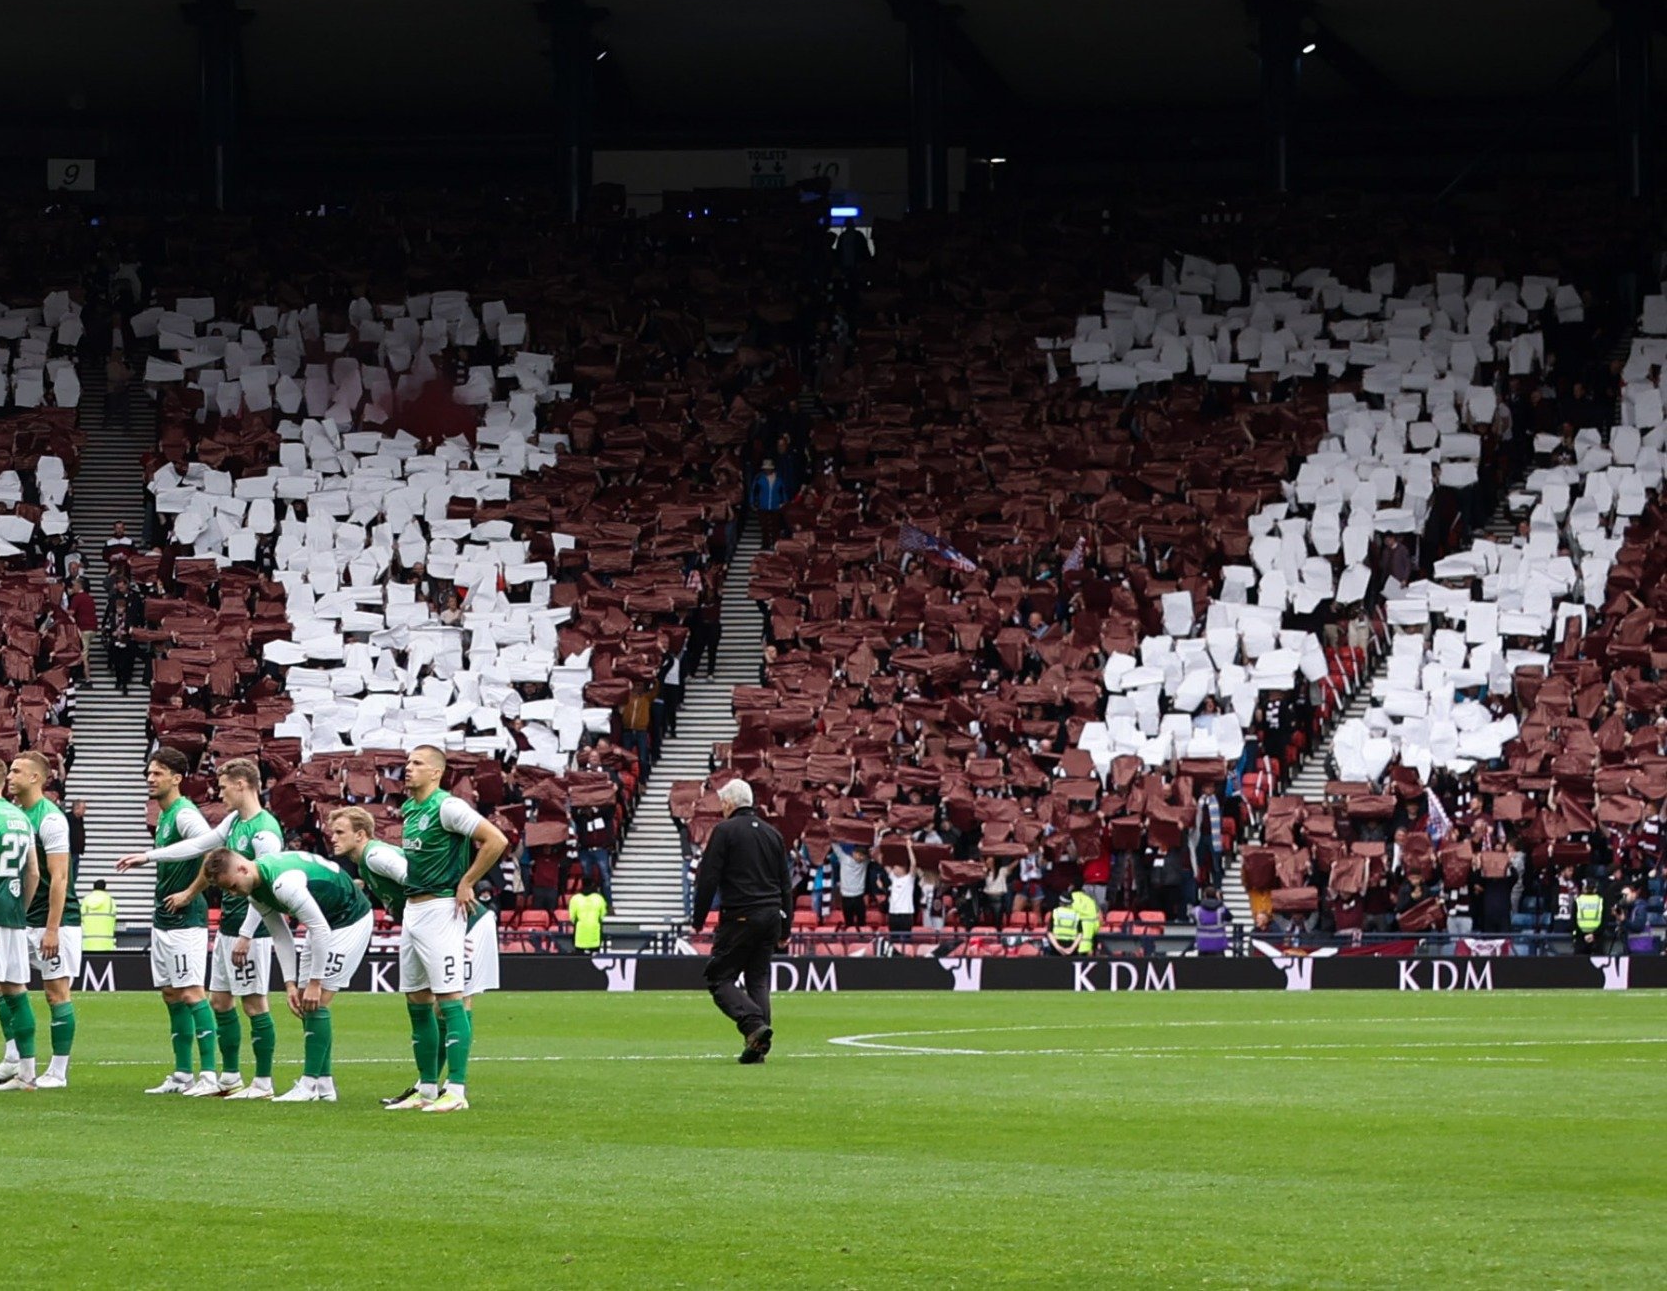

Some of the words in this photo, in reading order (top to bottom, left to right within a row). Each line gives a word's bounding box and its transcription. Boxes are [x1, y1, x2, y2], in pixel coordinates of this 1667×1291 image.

[747, 150, 788, 161] TOILETS
[63, 164, 79, 185] 9
[175, 953, 188, 973] 11
[444, 955, 455, 976] 2
[770, 961, 838, 992] DM
[1072, 961, 1176, 991] KDM
[1398, 960, 1493, 991] KDM
